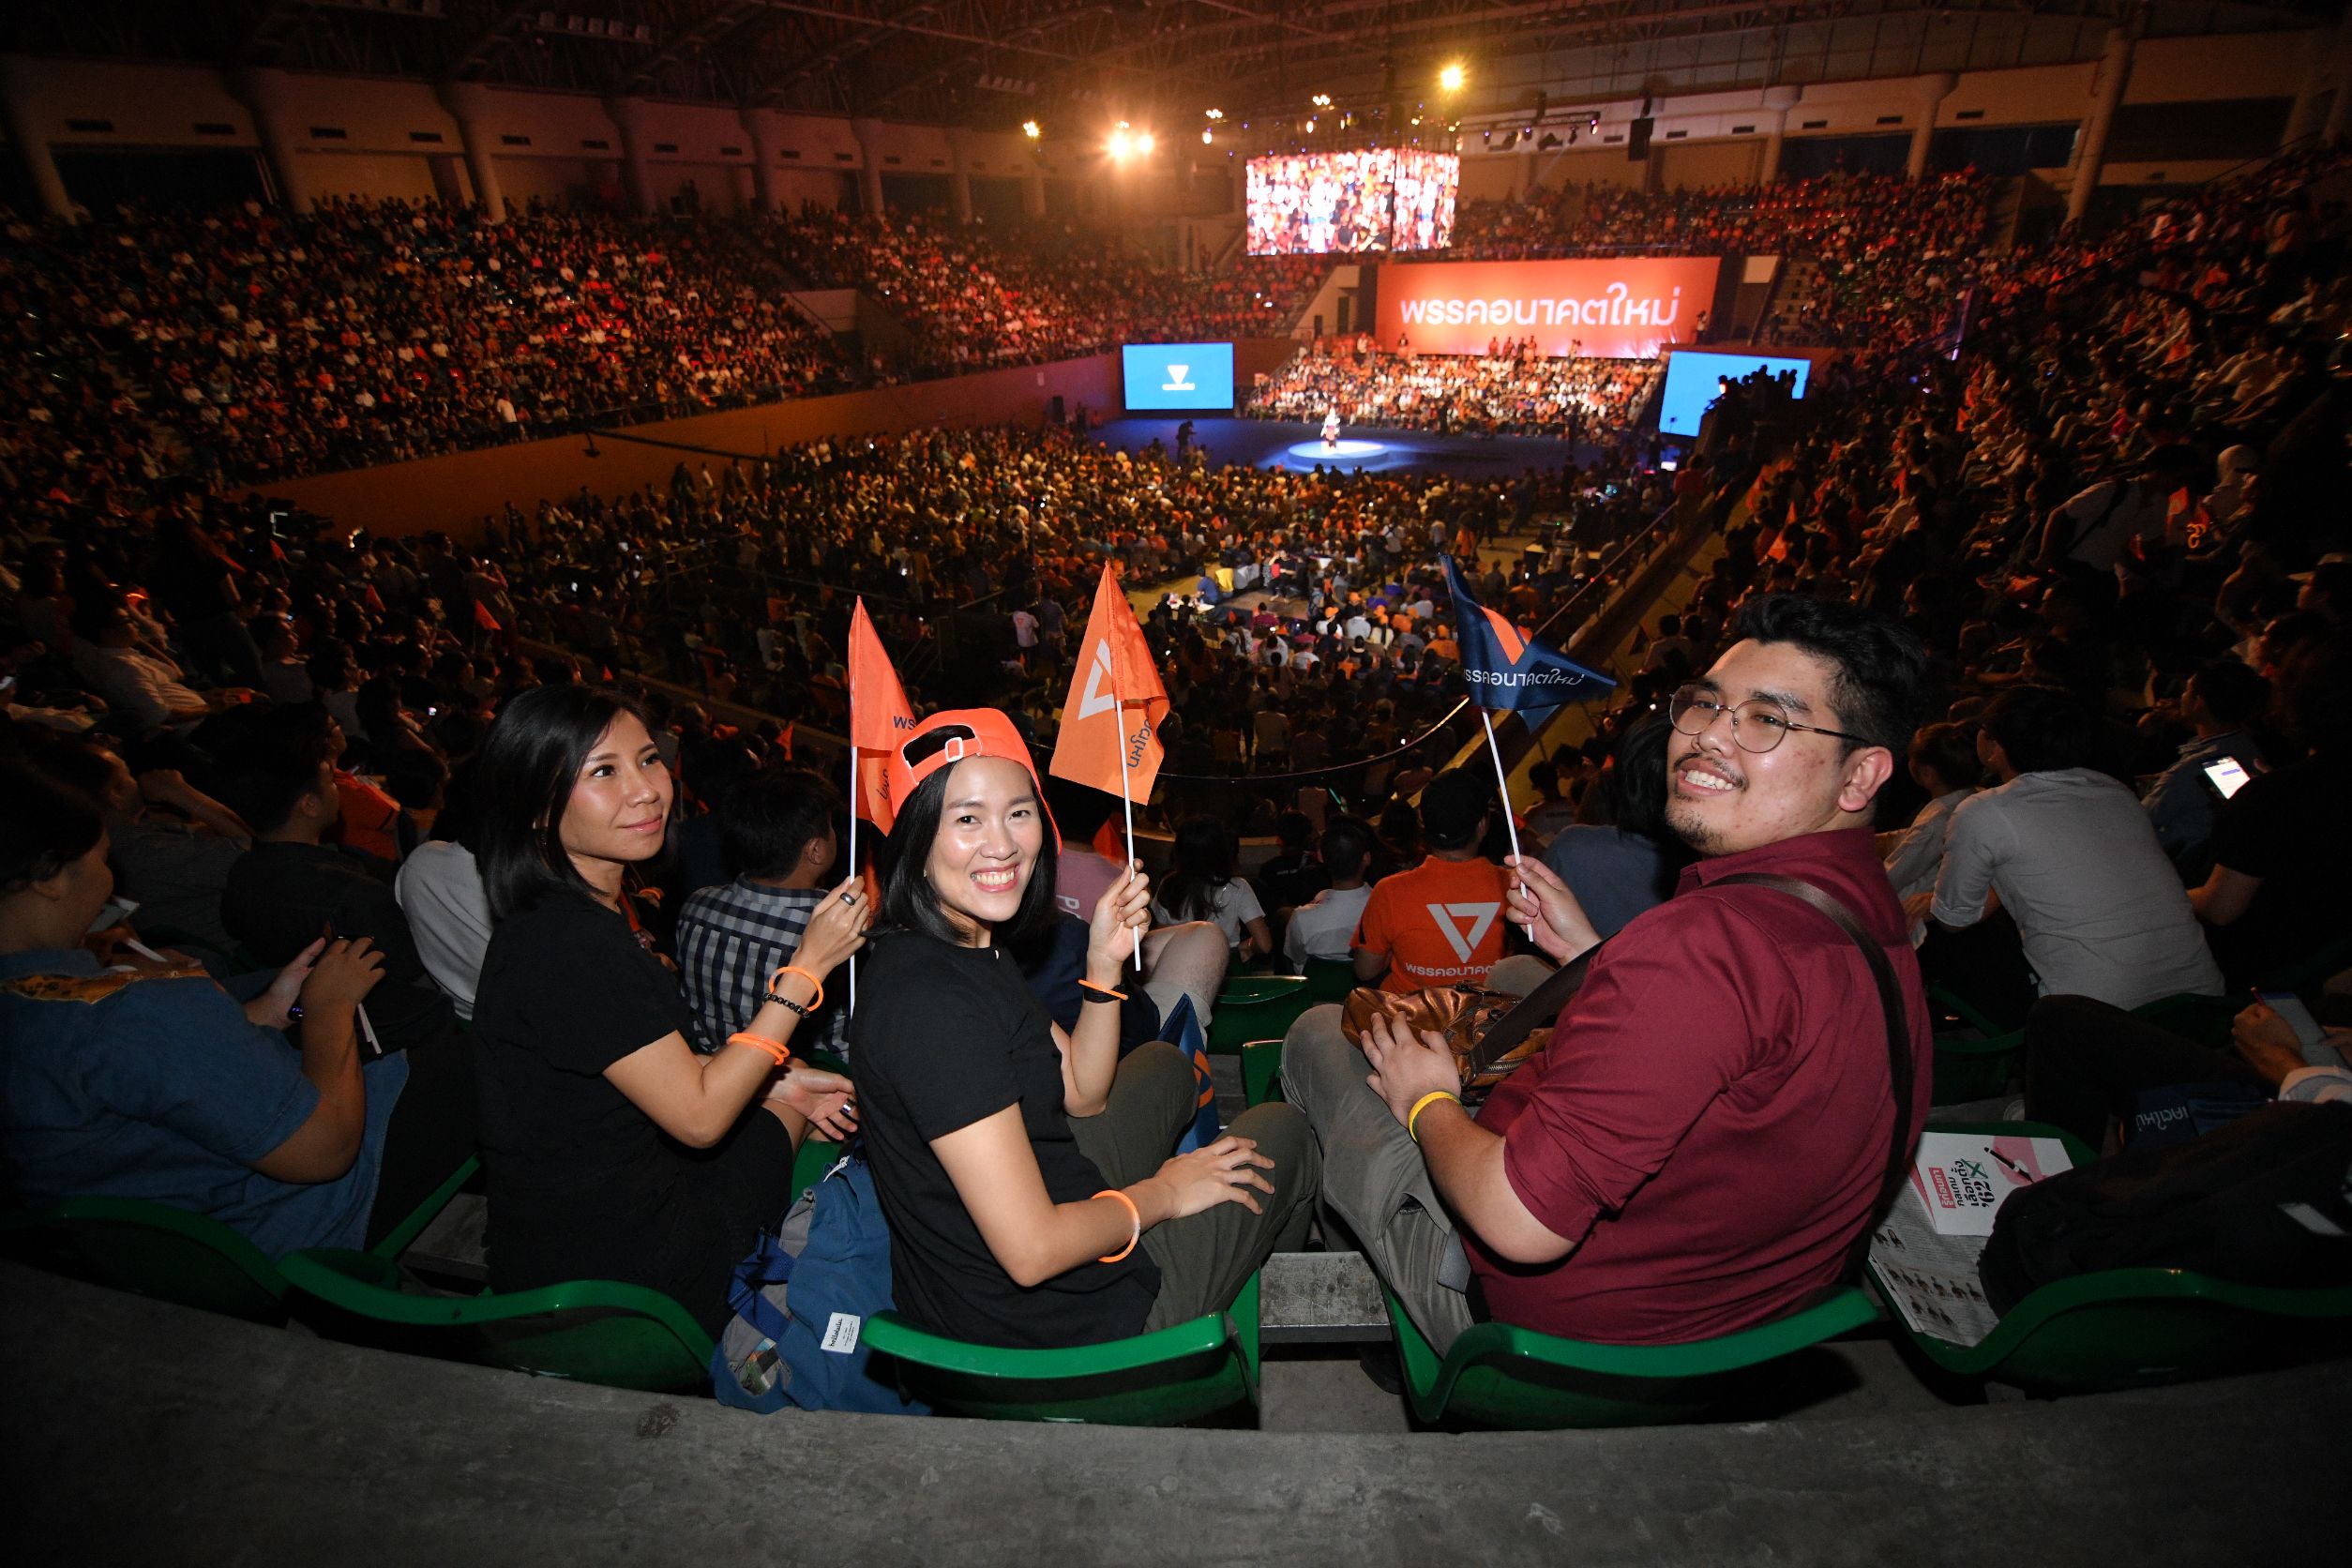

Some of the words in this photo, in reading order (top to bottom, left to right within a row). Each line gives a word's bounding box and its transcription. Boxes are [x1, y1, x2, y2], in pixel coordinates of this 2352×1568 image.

[1400, 281, 1681, 325] พรรคอนาคตใหม่
[1463, 667, 1585, 686] รรคอนาคตใหม่
[1951, 1160, 1980, 1207] เลือกตั้ง
